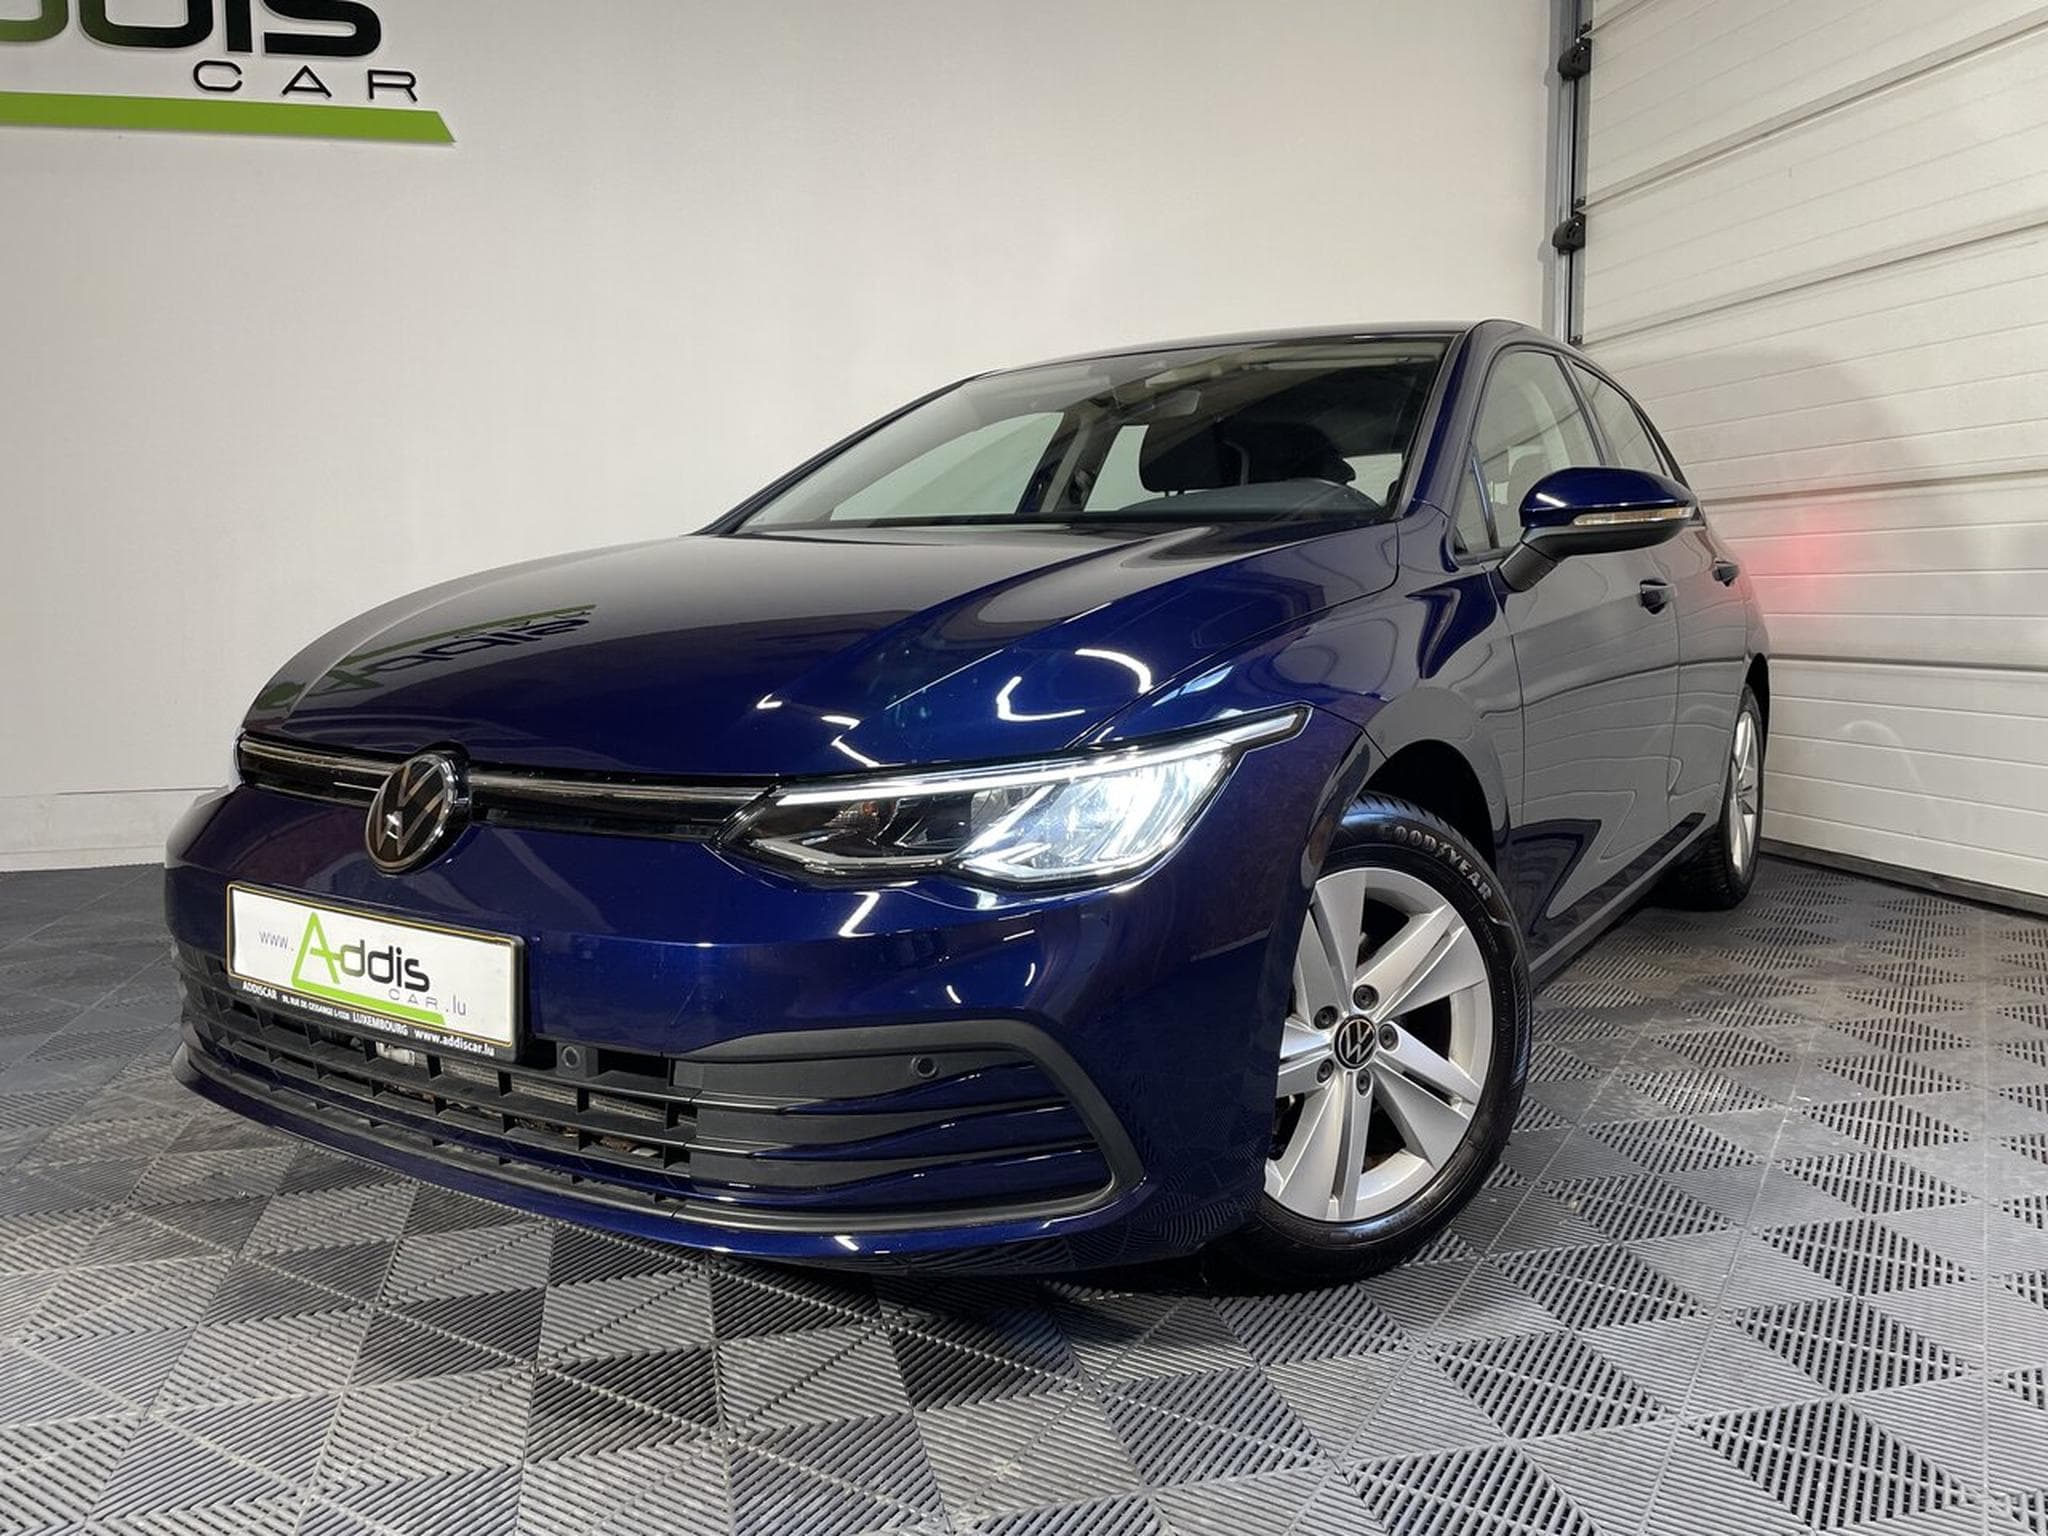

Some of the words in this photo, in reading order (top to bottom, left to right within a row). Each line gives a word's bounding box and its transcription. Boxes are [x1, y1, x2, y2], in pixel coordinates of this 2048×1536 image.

[193, 60, 418, 102] CAR
[291, 911, 431, 992] Addis
[388, 988, 439, 1010] CAR
[352, 1012, 409, 1036] LUXEMBOURG
[414, 1029, 495, 1057] www.addiscar.lu
